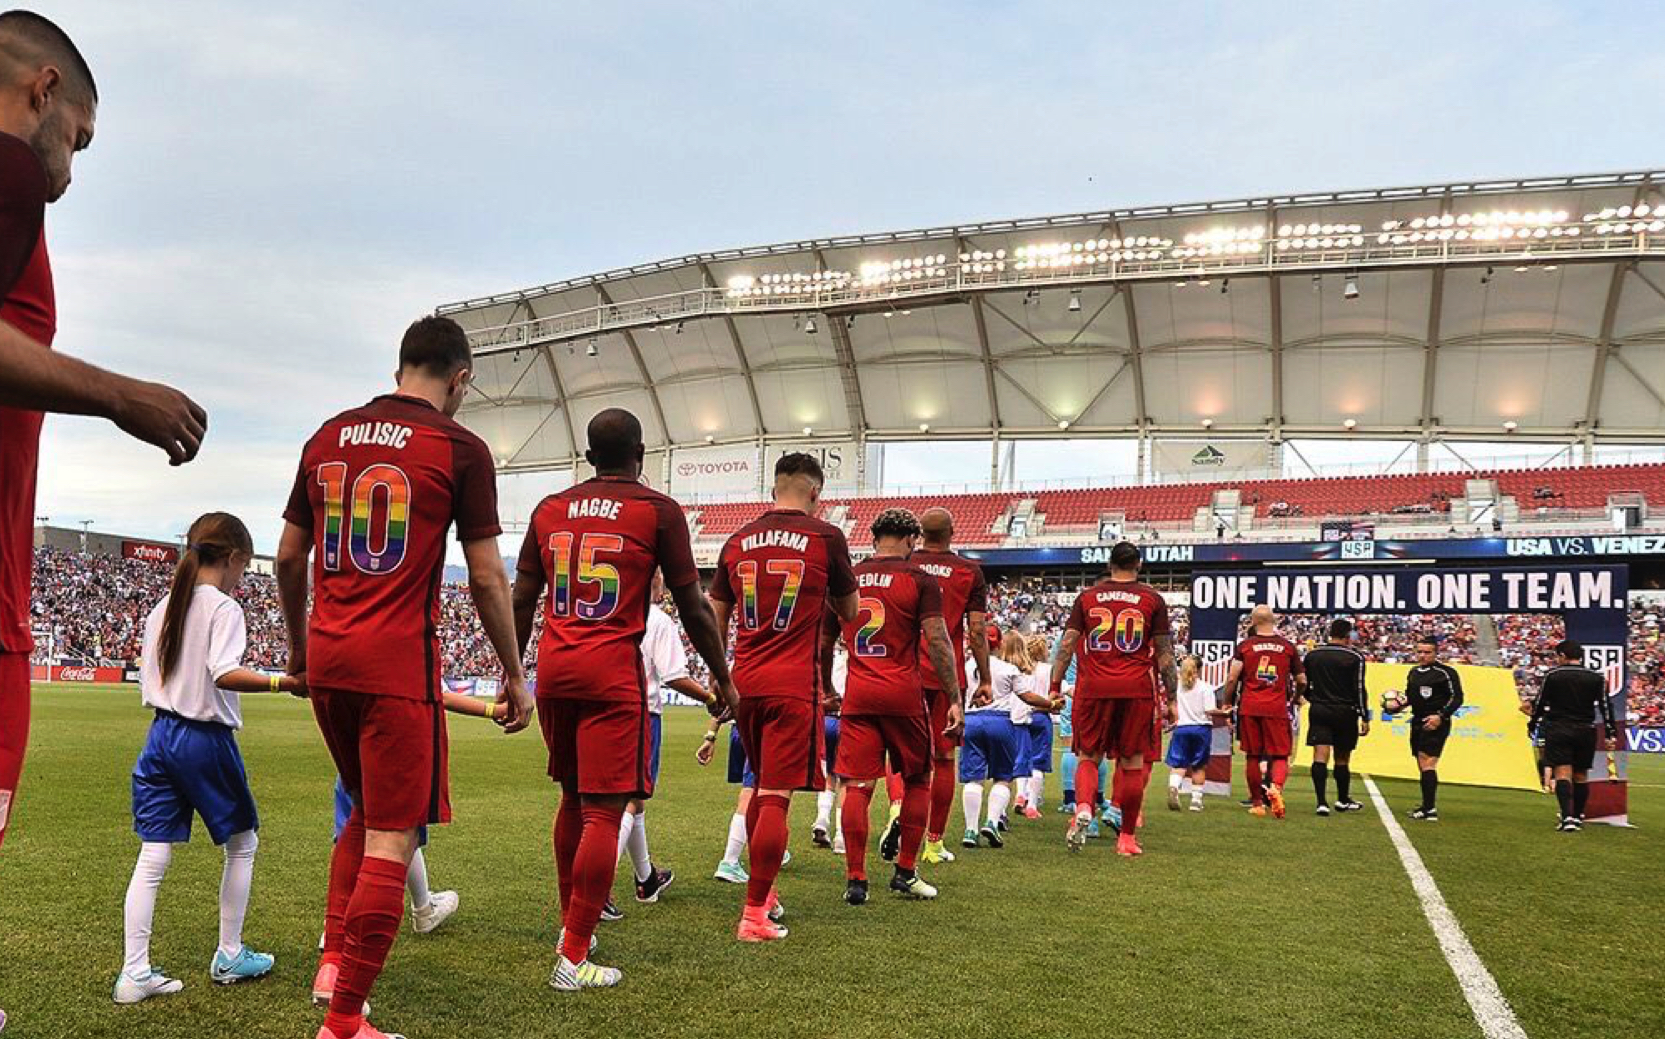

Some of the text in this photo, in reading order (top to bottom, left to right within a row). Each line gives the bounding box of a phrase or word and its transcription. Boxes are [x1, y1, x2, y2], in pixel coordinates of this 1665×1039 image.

[338, 421, 414, 450] PULISIC
[698, 461, 749, 474] TOYOTA
[317, 461, 412, 576] 10
[568, 498, 623, 520] NAGBE
[740, 528, 809, 552] VILLAFANA
[1506, 537, 1665, 556] USA VS. VENEZ
[1146, 545, 1194, 562] UTAH
[548, 532, 624, 621] 15
[856, 572, 894, 588] EDLIN
[737, 559, 805, 632] 17
[1193, 571, 1625, 609] ONE NATION. ONE TEAM.
[855, 597, 887, 657] 2
[1089, 607, 1145, 654] 20
[1195, 642, 1231, 662] USA
[1590, 648, 1619, 671] SA
[1256, 655, 1279, 686] 4
